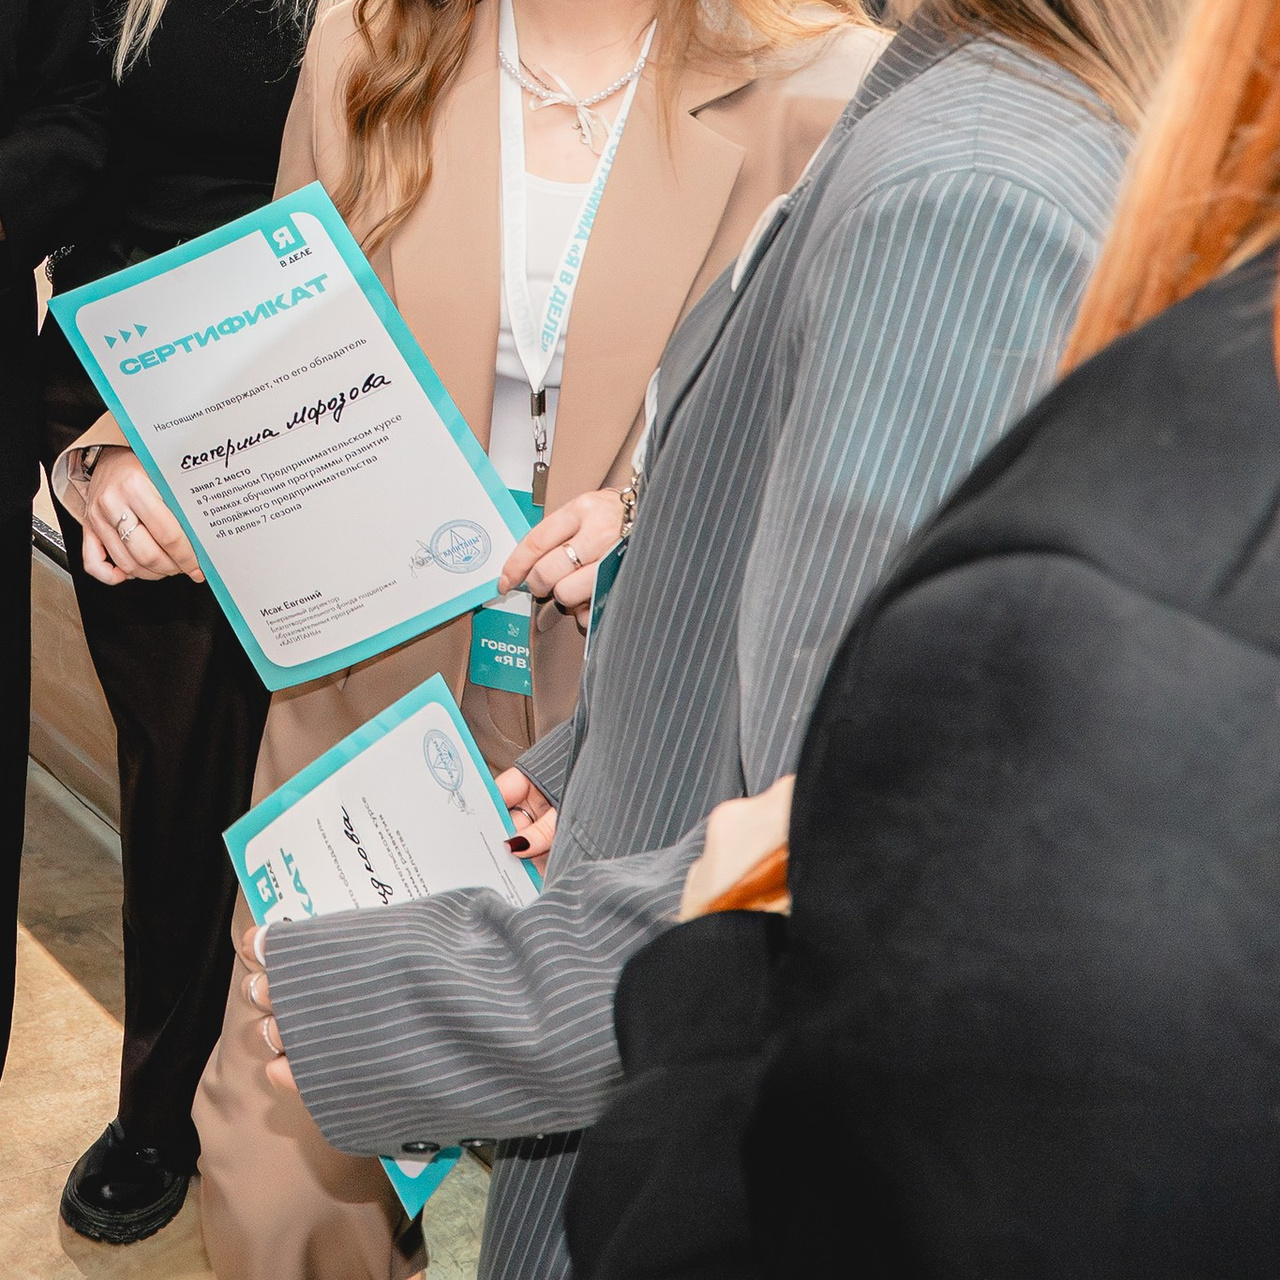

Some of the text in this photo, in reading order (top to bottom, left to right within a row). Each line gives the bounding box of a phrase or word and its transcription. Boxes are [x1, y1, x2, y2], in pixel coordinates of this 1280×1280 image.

[272, 225, 296, 250] Я
[280, 247, 313, 268] В ДЕЛЕ
[565, 244, 580, 269] «Я
[559, 270, 574, 286] В
[119, 273, 328, 376] СЕРТИФИКАТ
[541, 285, 567, 352] ДЕЛЕ»
[153, 337, 368, 432] Настоящим подтверждает, что его обладатель
[181, 373, 392, 469] Екатерина Морозова
[189, 468, 251, 494] занял 2 место
[202, 478, 260, 503] 9-недельном
[261, 429, 373, 483] Предпринимательском
[373, 414, 402, 433] курсе
[210, 501, 242, 517] рамках
[243, 482, 287, 503] обучения
[287, 456, 344, 486] программы
[344, 435, 390, 462] развития
[210, 455, 378, 528] молодёжного предпринимательства
[216, 529, 228, 539] «Я
[235, 520, 261, 534] деле»
[261, 515, 268, 524] 7
[270, 503, 302, 521] сезона
[260, 589, 323, 617] Исак Евгений
[494, 654, 527, 670] «Я В
[362, 796, 379, 828] курсе
[317, 818, 349, 887] обладатель
[379, 814, 407, 865] развития
[396, 830, 430, 897] мательства
[256, 876, 272, 902] Я
[378, 832, 415, 902] мательском
